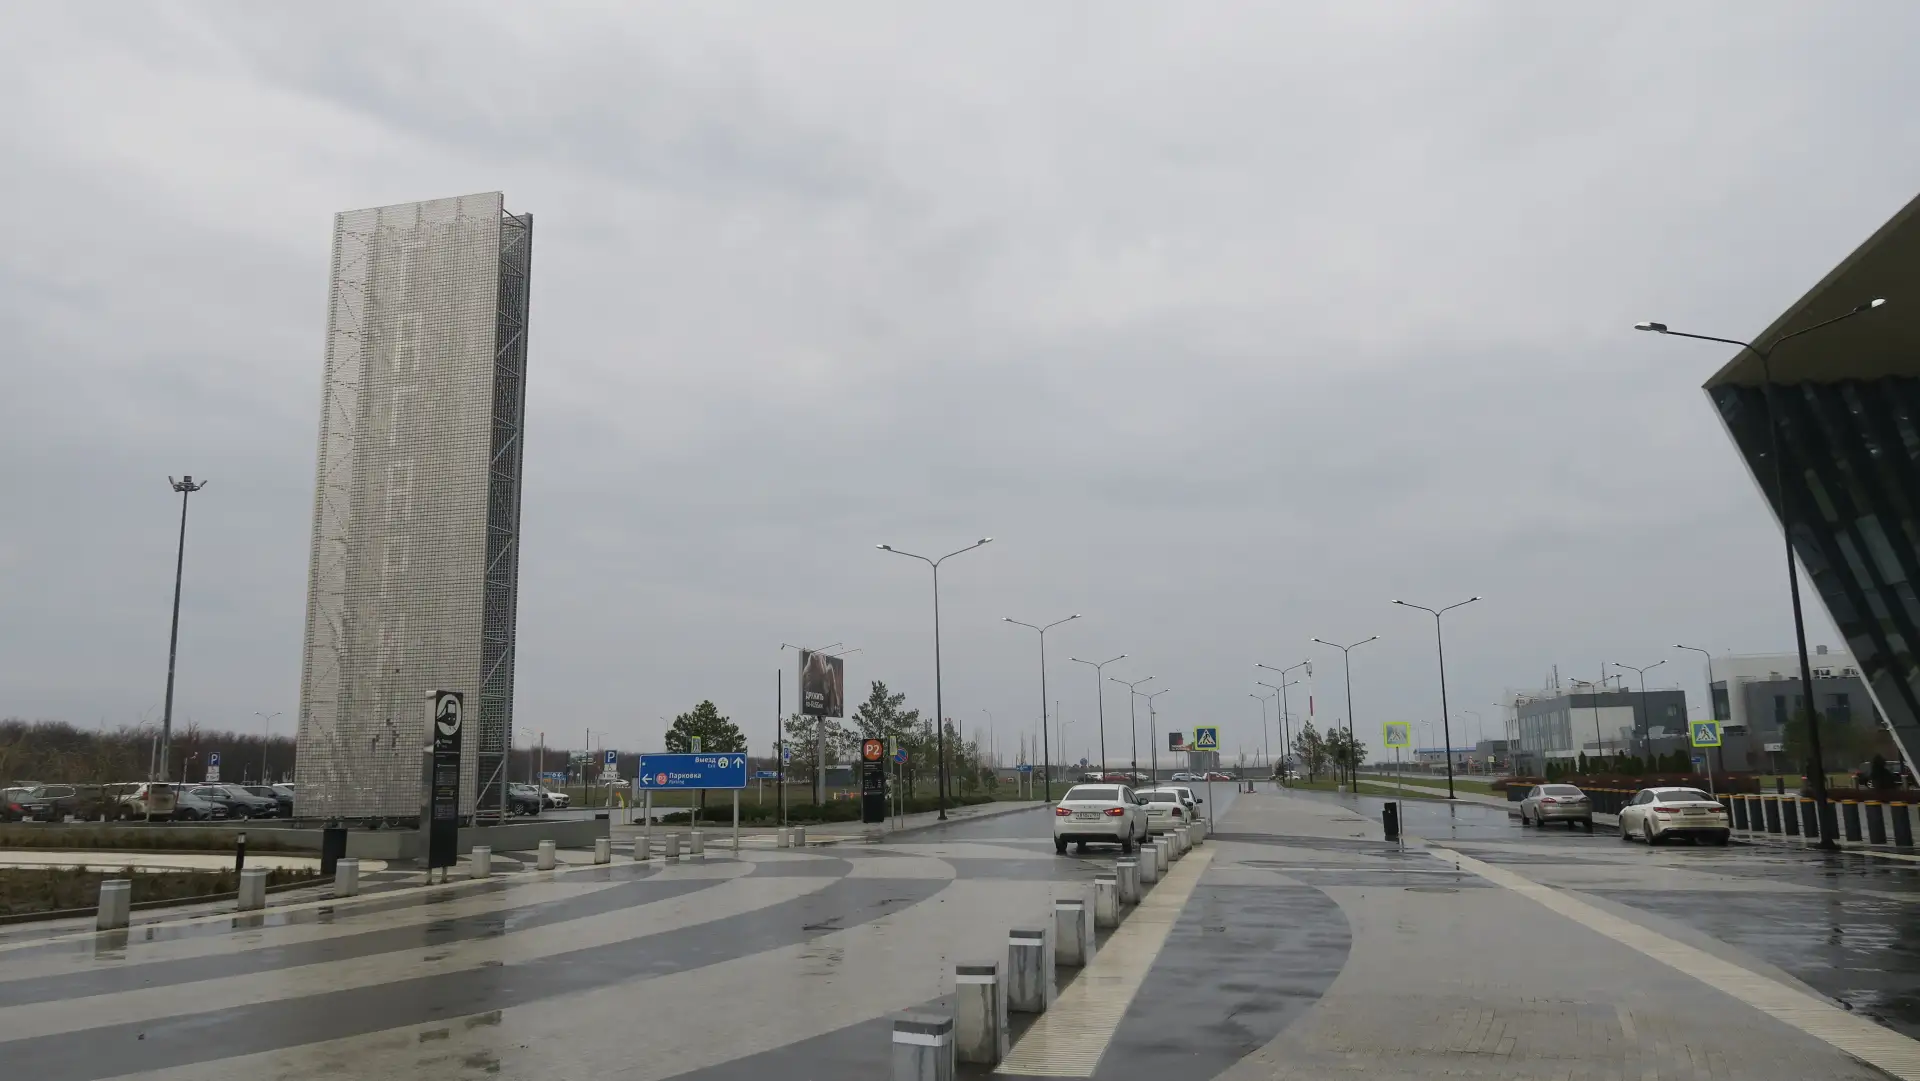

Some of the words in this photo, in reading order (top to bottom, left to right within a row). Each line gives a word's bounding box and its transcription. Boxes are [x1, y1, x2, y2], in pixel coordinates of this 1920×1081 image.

[866, 744, 880, 756] P2
[211, 754, 218, 765] P
[607, 751, 615, 763] P
[695, 756, 717, 764] Выезд
[669, 772, 702, 780] Парковка
